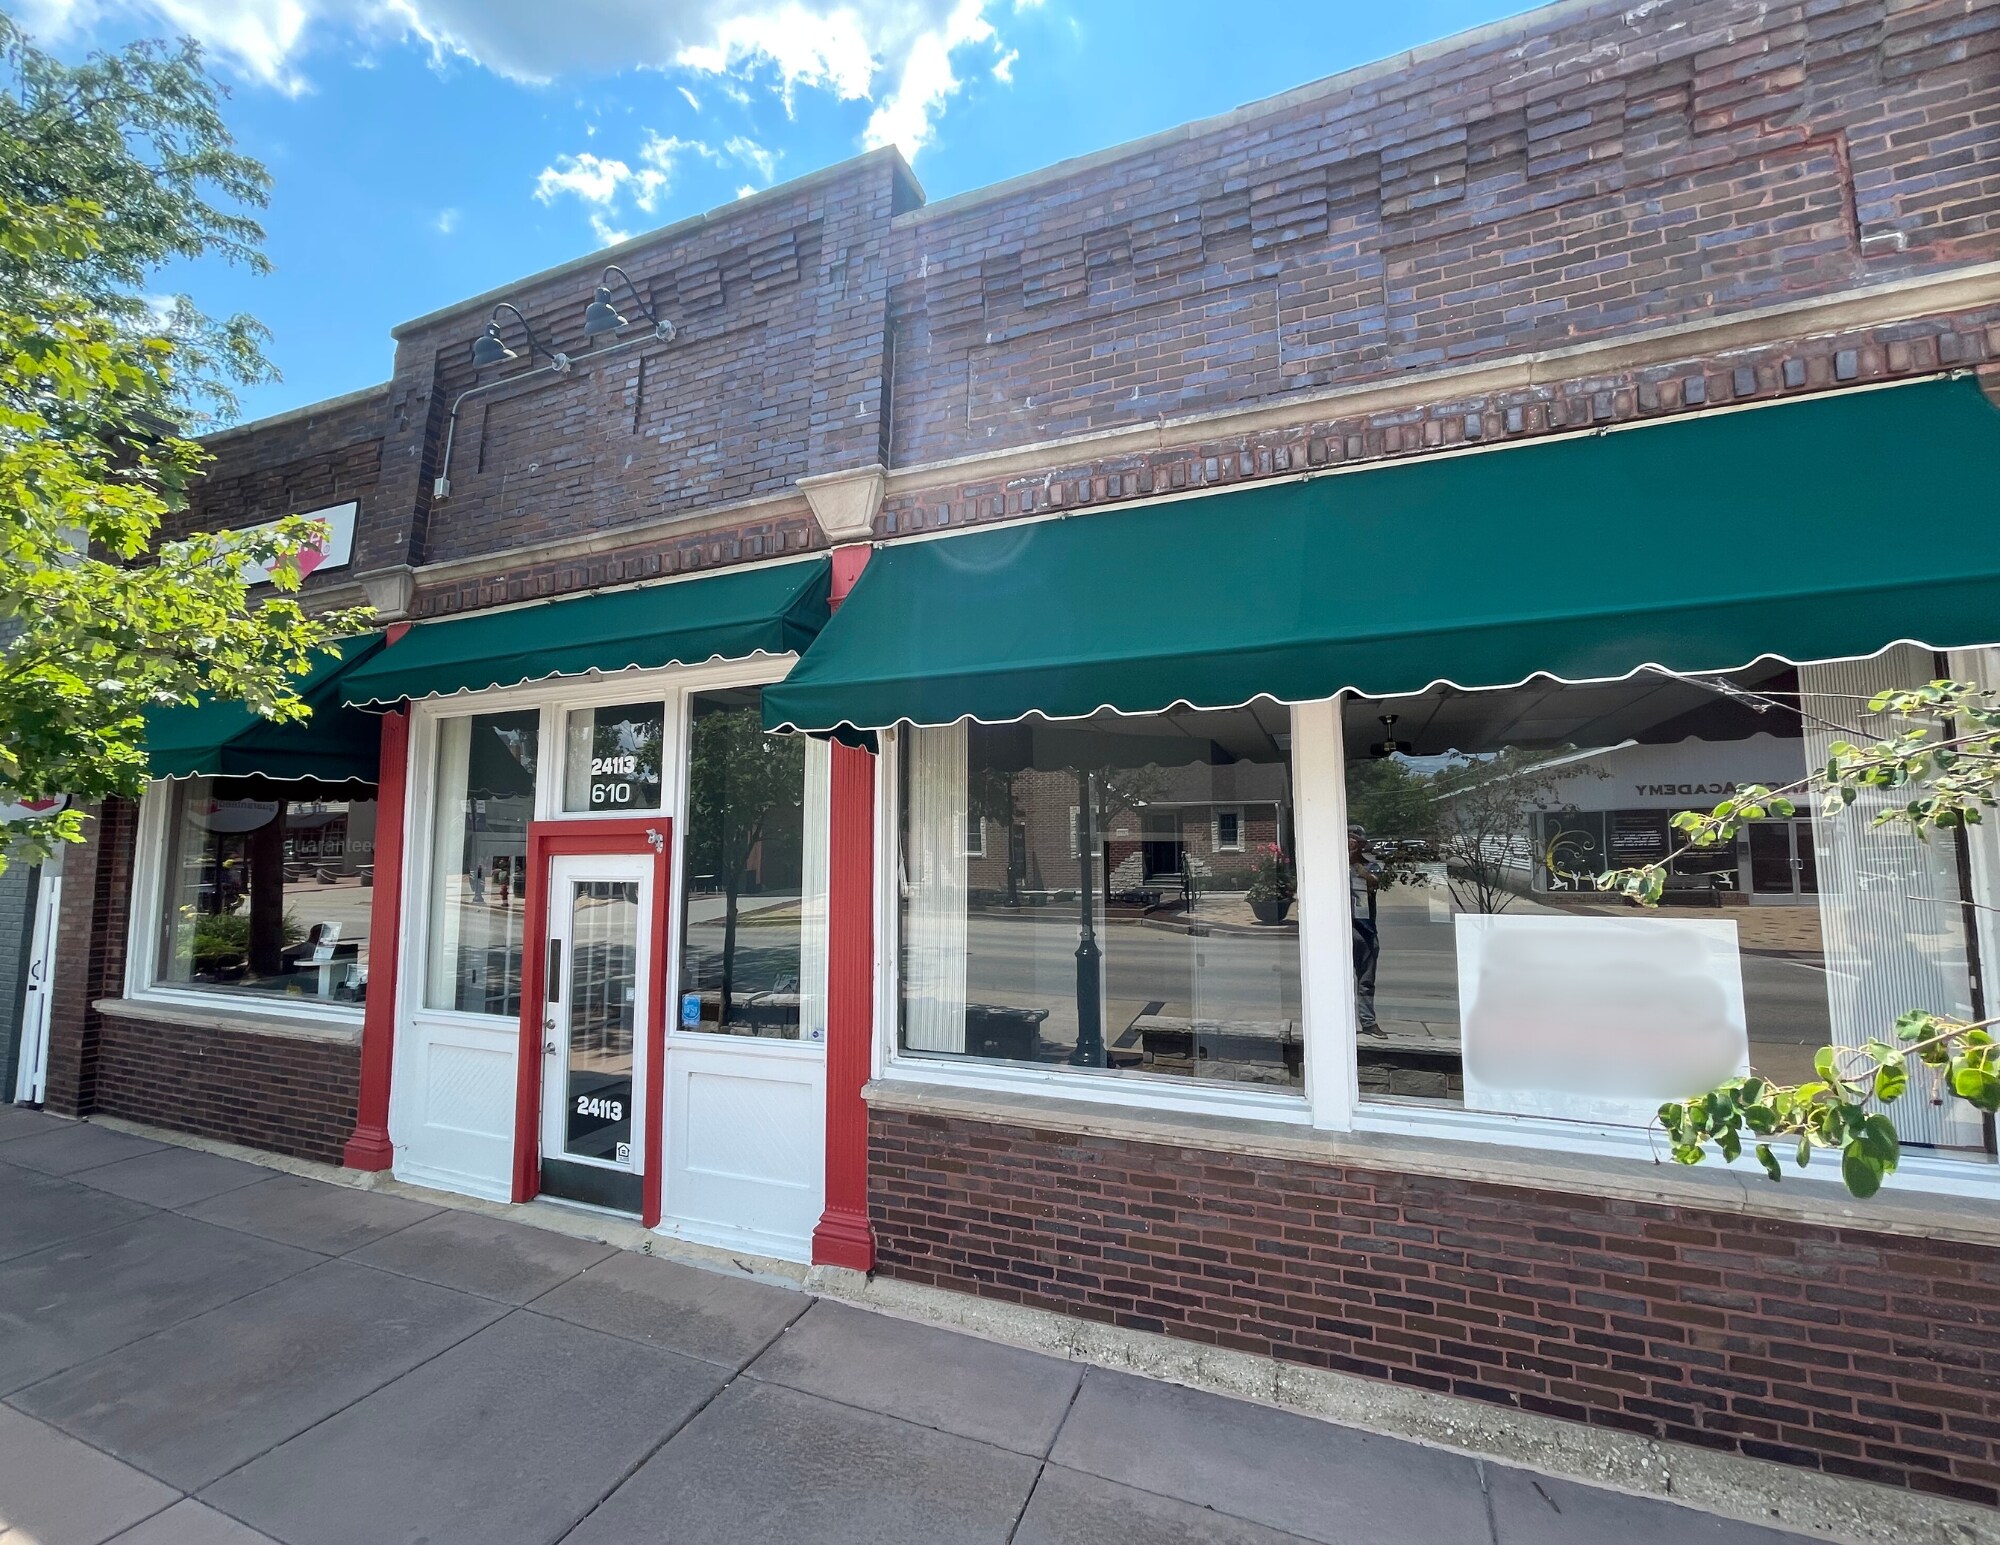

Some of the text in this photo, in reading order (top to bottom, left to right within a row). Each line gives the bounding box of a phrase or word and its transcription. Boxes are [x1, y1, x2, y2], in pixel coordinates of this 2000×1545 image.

[591, 755, 635, 776] 24113
[591, 783, 631, 803] 610
[281, 837, 375, 856] guarantee
[577, 1095, 623, 1122] 24113
